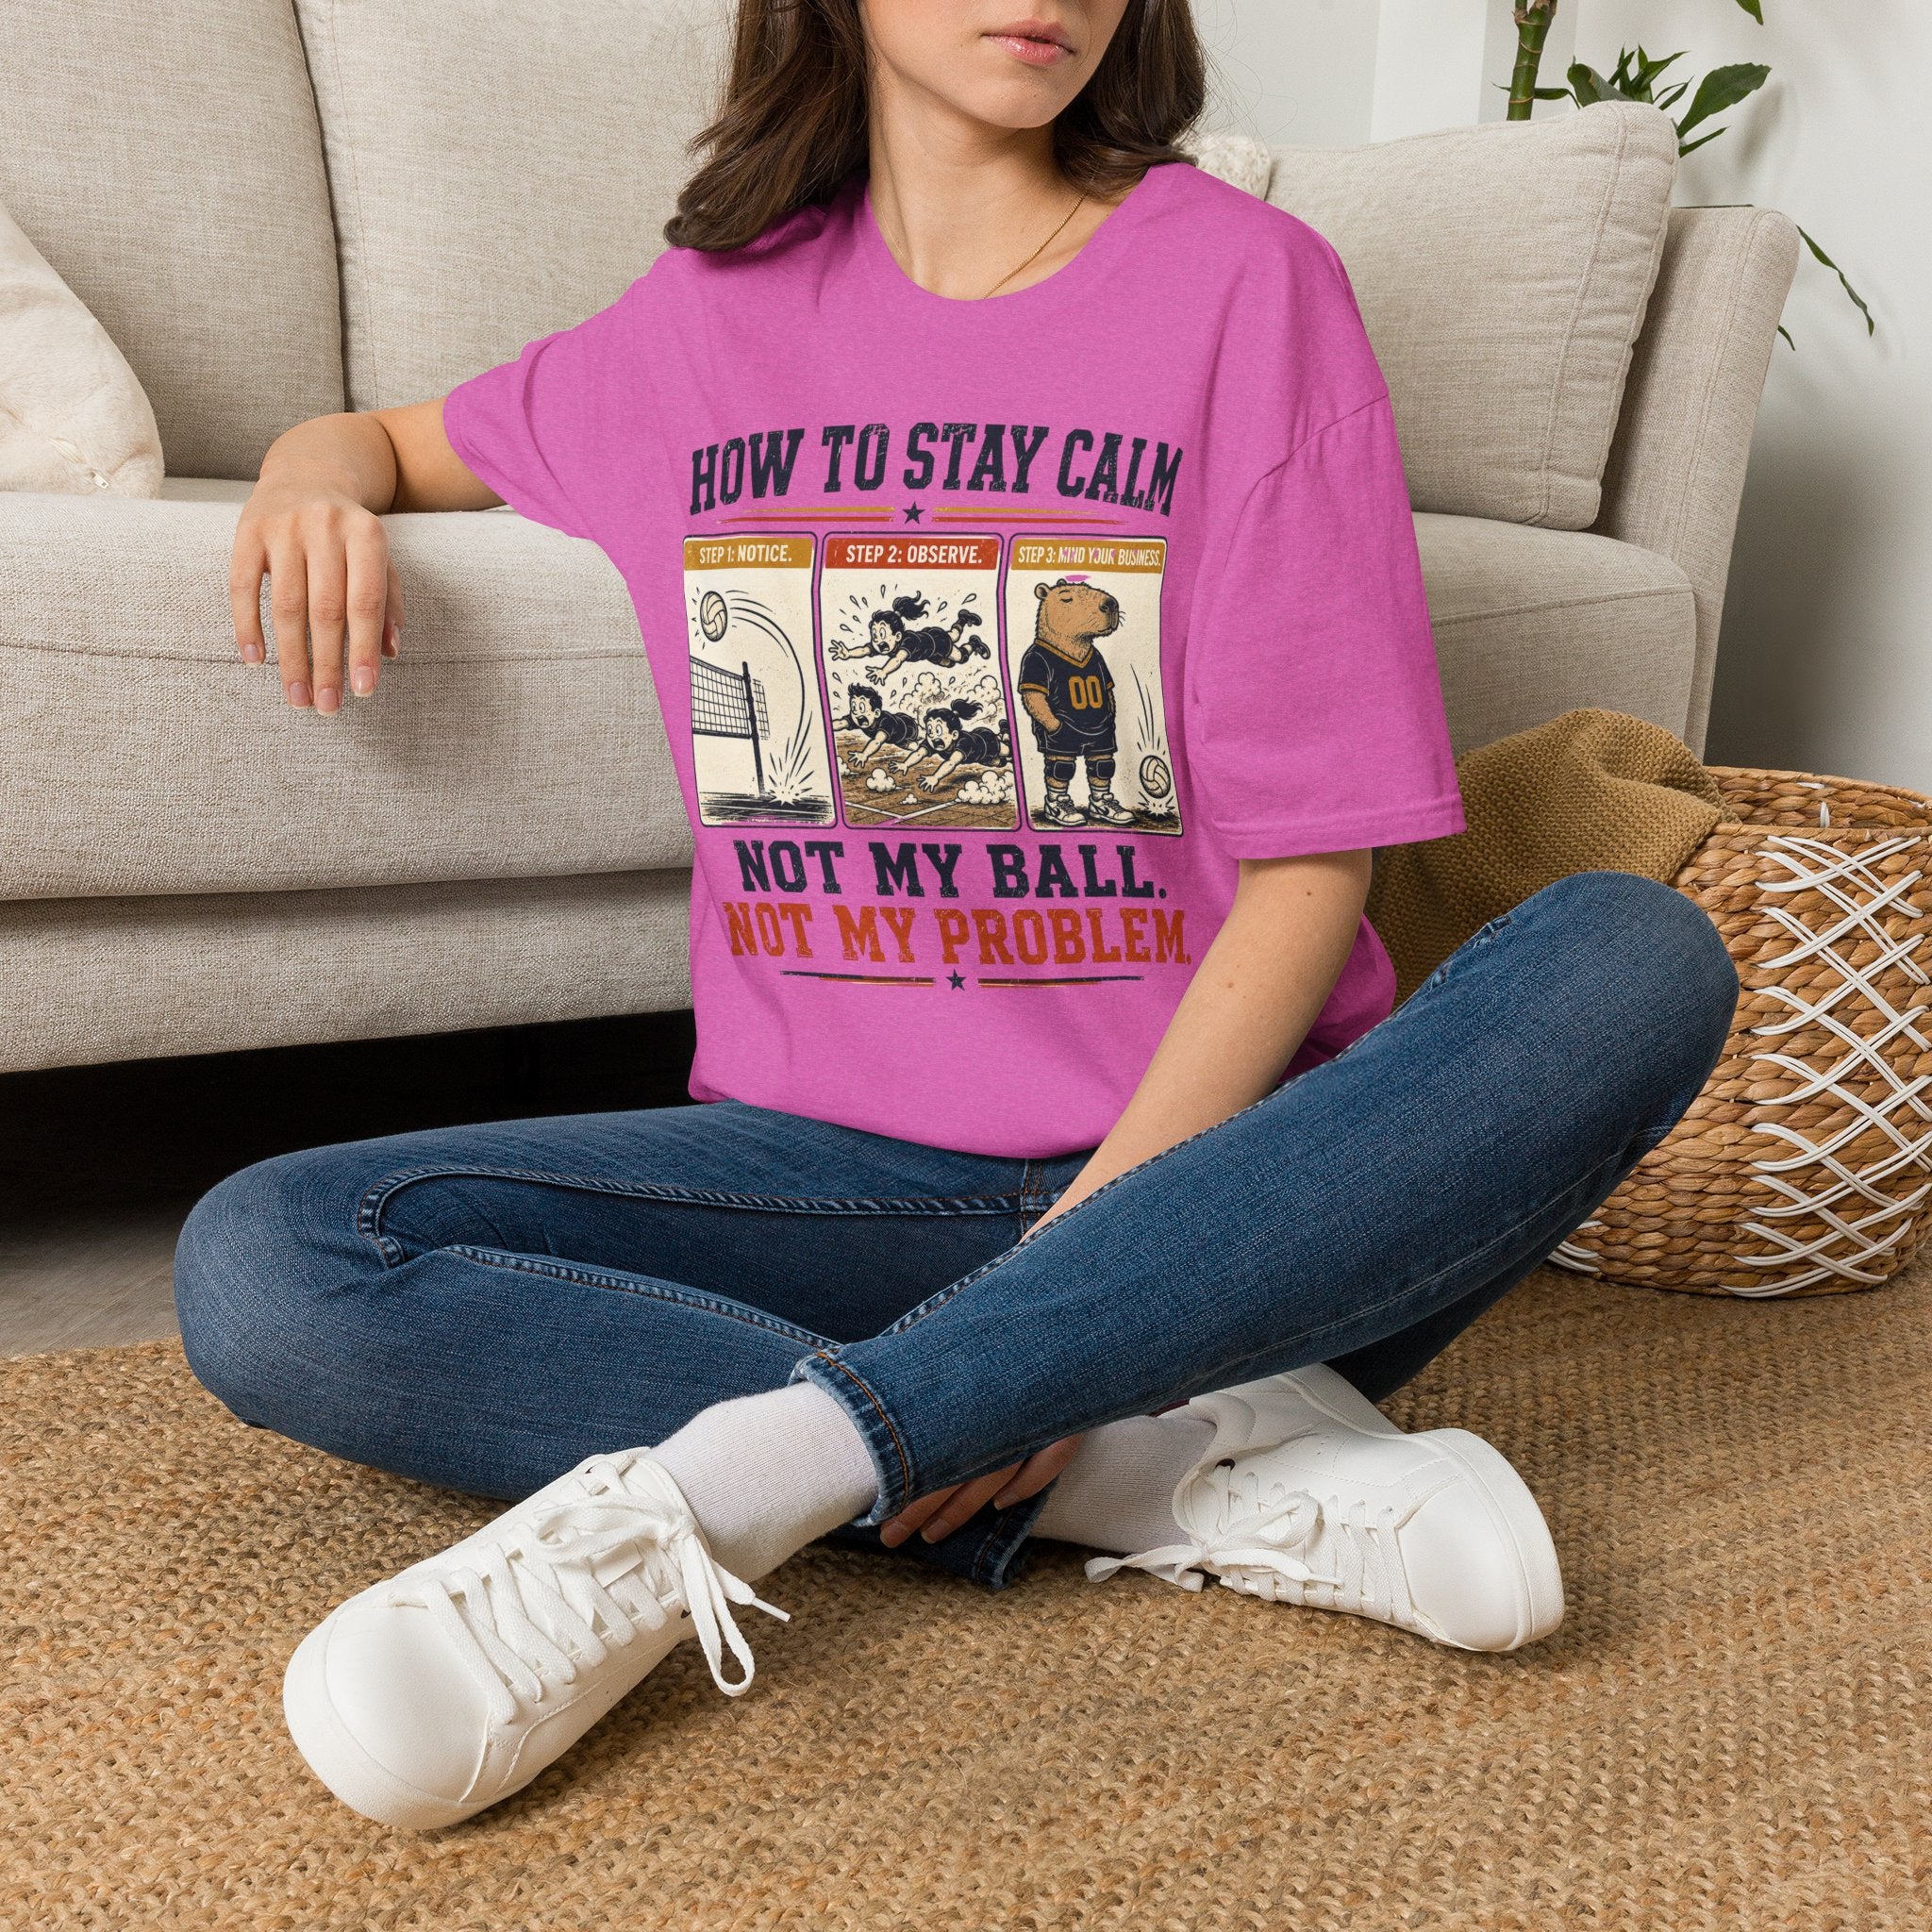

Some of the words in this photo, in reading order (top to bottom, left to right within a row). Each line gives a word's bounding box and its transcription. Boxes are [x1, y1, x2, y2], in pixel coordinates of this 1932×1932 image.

[690, 427, 805, 516] HOW
[822, 423, 890, 493] TO
[903, 422, 1049, 492] STAY
[1057, 427, 1184, 517] CALM
[699, 546, 724, 564] STEP
[727, 546, 735, 562] 1:
[737, 544, 792, 562] NOTICE.
[845, 544, 887, 563] STEP
[889, 545, 902, 563] 2:
[907, 544, 982, 564] OBSERVE.
[1018, 545, 1044, 563] STEP
[1045, 546, 1056, 563] 3:
[1058, 546, 1085, 564] MIND
[1088, 547, 1115, 564] YOUR
[1117, 548, 1161, 566] BUSINESS.
[1068, 675, 1104, 710] 00
[733, 840, 844, 892] NOT
[869, 842, 962, 898] MY
[985, 844, 1167, 899] BALL.
[722, 902, 813, 958] NOT
[832, 905, 916, 963] MY
[933, 908, 1191, 966] PROBLEM.
